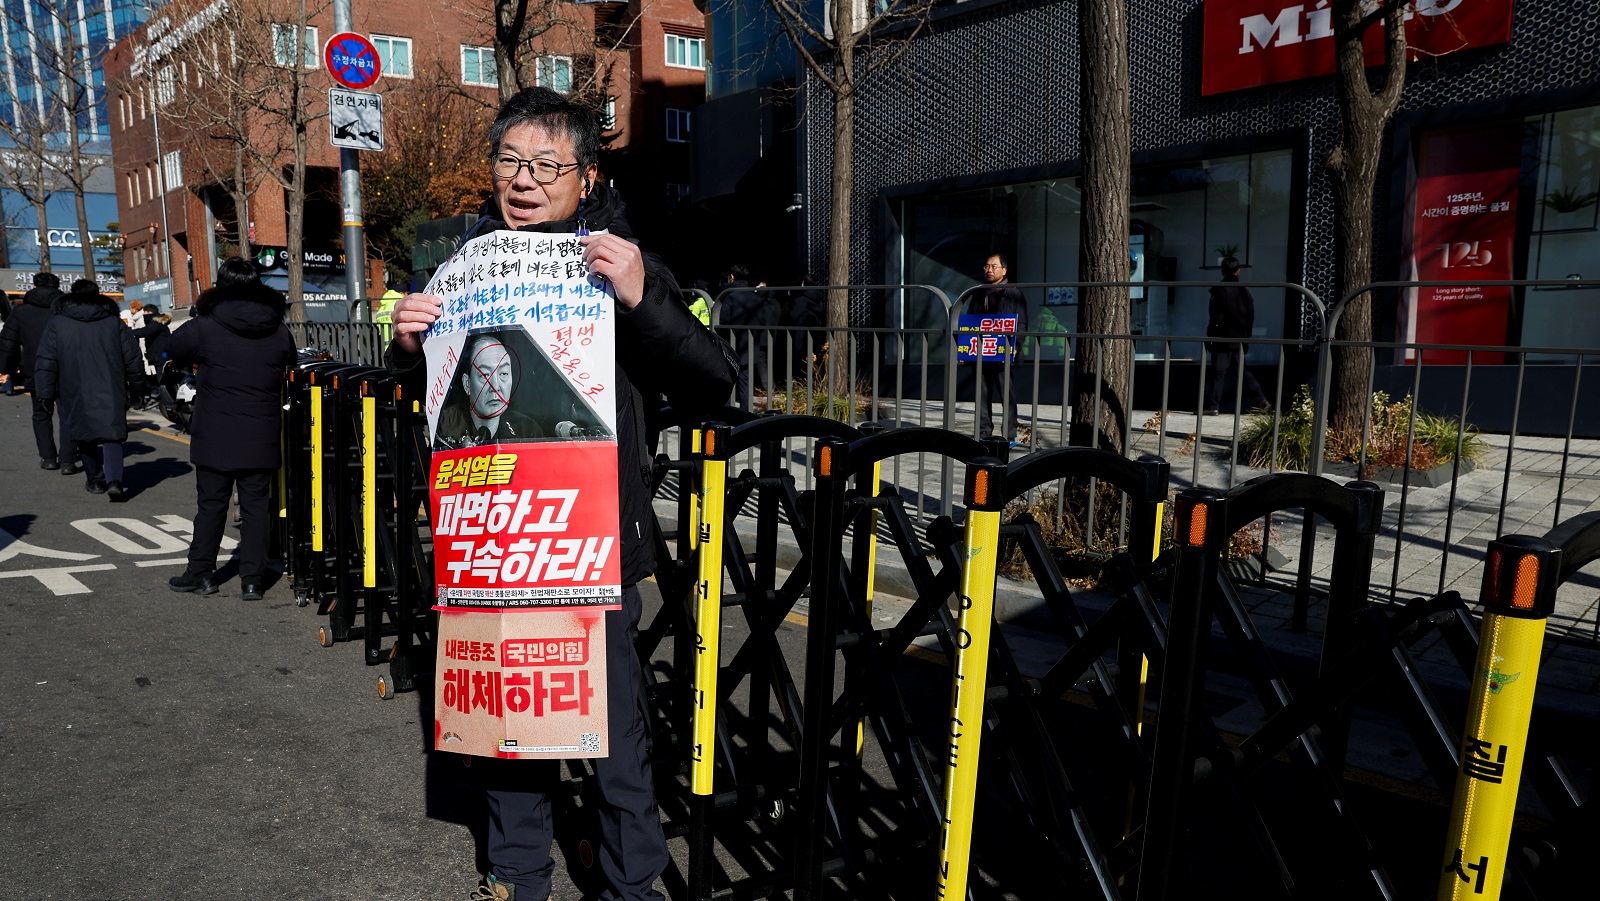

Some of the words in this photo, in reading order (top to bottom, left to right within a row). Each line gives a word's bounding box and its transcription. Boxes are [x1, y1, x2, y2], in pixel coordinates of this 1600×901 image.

[333, 54, 374, 69] 주정차금지
[334, 94, 379, 110] 견인지역
[1447, 191, 1485, 203] 125주년,
[1422, 207, 1449, 218] 시간이
[1451, 203, 1488, 217] 증명하는
[1490, 201, 1511, 212] 품질
[304, 251, 334, 263] Made
[1436, 240, 1493, 268] 125
[1443, 294, 1457, 302] years
[1465, 293, 1485, 301] quality.
[551, 322, 595, 347] 평생
[434, 453, 519, 490] 윤석열을
[435, 488, 580, 536] 파면하고
[446, 536, 615, 584] 구속하라!
[530, 588, 571, 597] 헌법재판소로
[445, 639, 496, 662] 내란동조
[506, 641, 583, 664] 국민의힘
[443, 668, 594, 718] 해체하라
